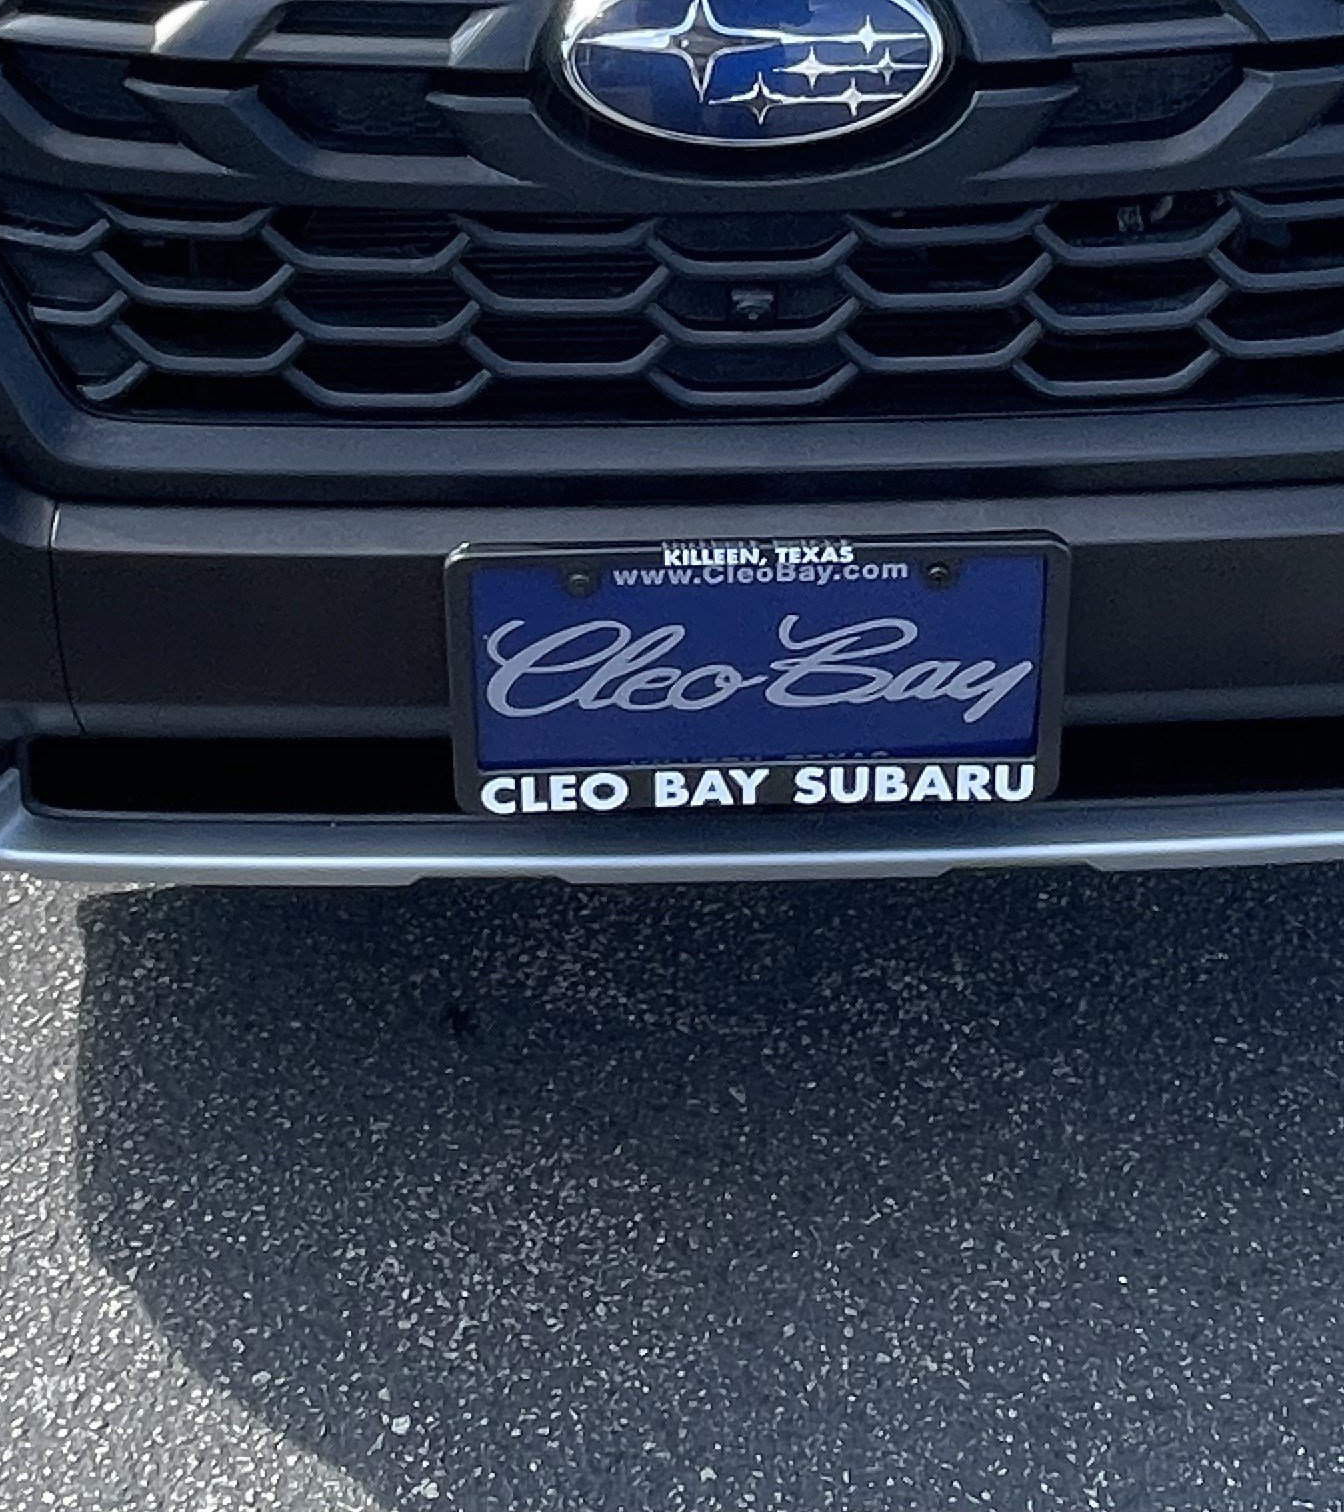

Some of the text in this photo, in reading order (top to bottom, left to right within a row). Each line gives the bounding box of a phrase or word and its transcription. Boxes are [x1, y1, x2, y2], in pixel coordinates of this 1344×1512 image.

[612, 563, 908, 586] www.CleoBay.com
[664, 546, 855, 566] KILLEEN, TEXAS
[486, 614, 1034, 724] Cleo Bay
[480, 764, 1035, 815] CLEO BAY SUBARU
